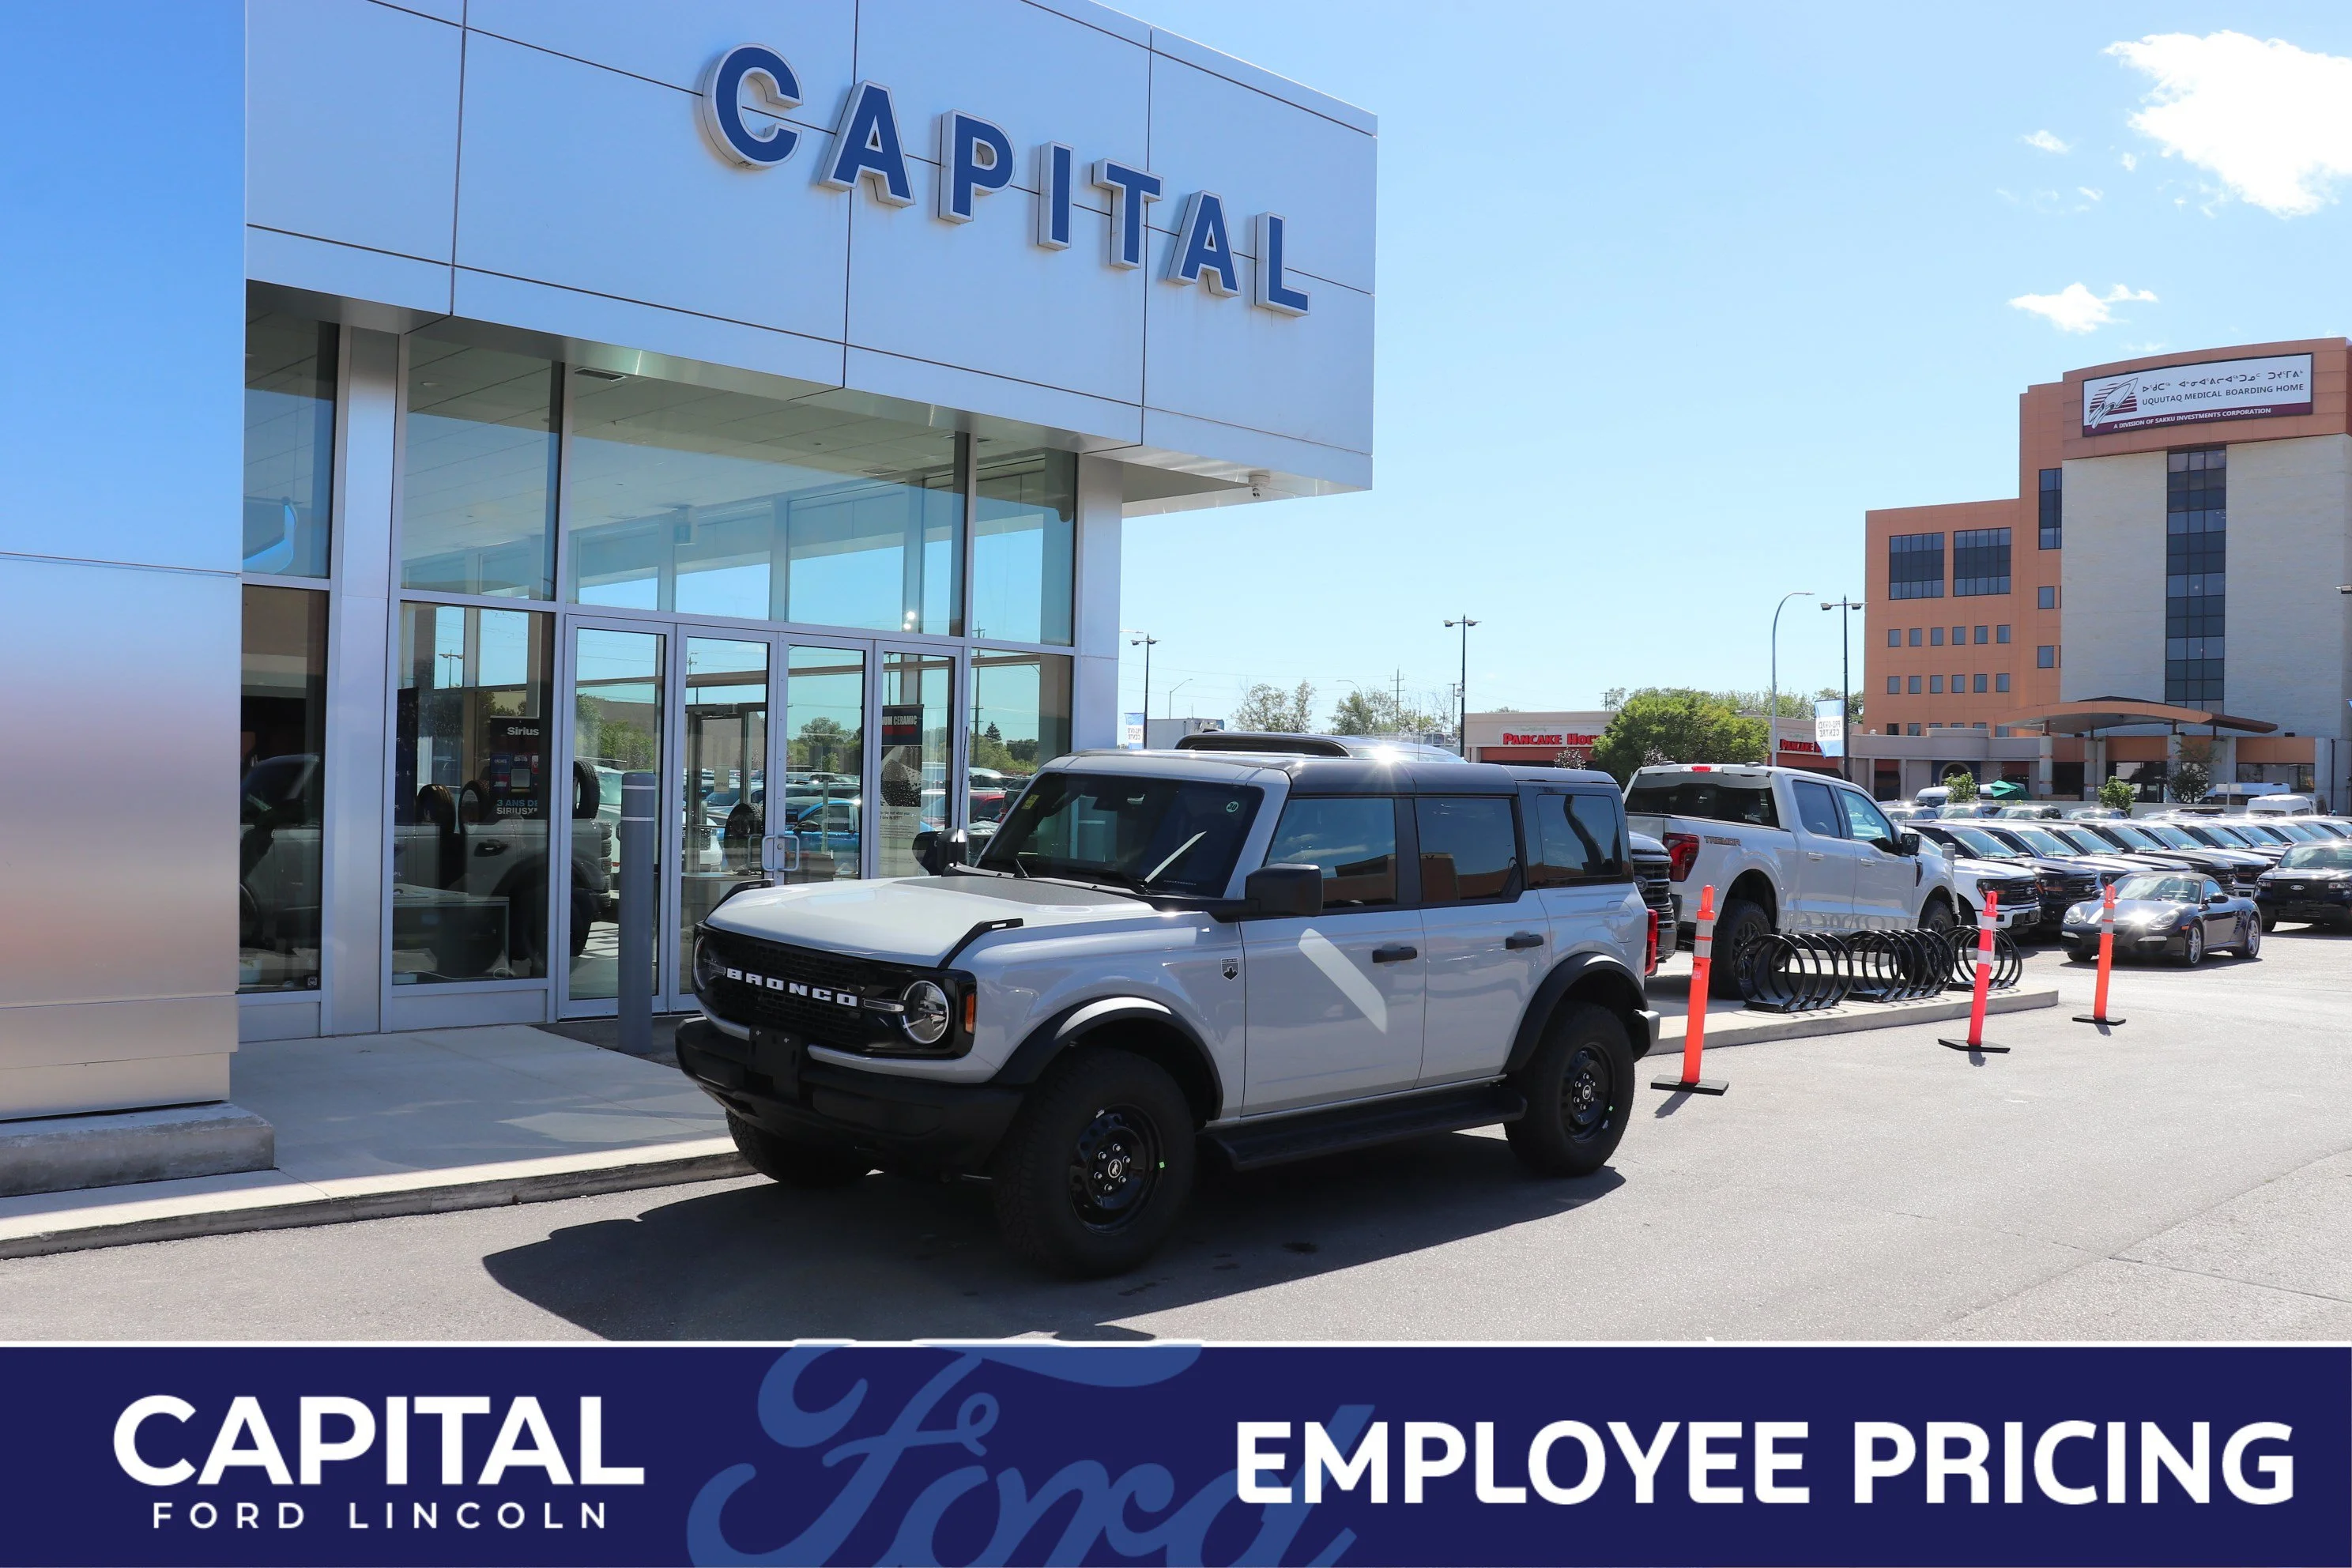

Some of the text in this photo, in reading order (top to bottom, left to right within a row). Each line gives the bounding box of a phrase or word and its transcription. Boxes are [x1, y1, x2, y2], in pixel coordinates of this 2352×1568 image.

[702, 43, 1311, 317] CAPITAL
[2143, 383, 2304, 405] UQUUTAQ MEDICAL BOARDING HOME
[2177, 412, 2221, 421] INVESTMENTS
[2222, 408, 2271, 416] CORPORATION
[894, 715, 918, 726] CERAMIC
[507, 726, 539, 736] Sirius
[1503, 733, 1562, 745] PANCAKE
[1227, 802, 1238, 811] 30
[1704, 835, 1741, 846] TREMOR
[726, 967, 858, 1007] BRONCO
